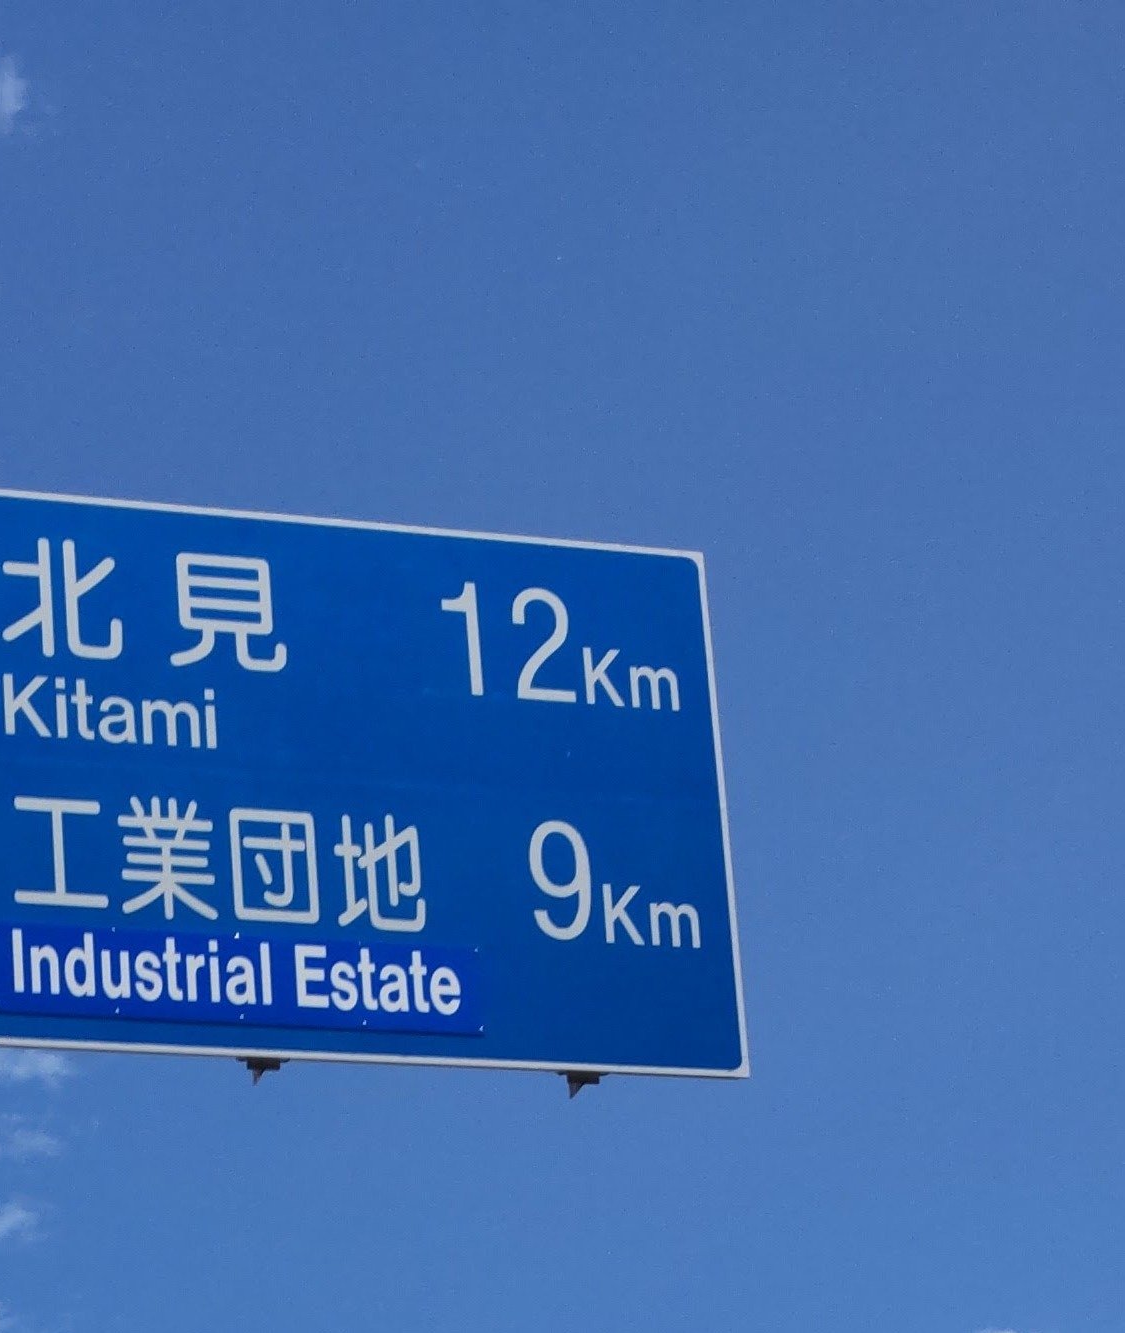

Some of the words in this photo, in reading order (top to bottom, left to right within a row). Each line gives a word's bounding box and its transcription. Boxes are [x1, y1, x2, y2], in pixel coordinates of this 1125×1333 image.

[2, 538, 287, 672] 北見
[3, 673, 217, 749] Kitami
[14, 796, 426, 932] 工業団地
[12, 929, 273, 1005] Industrial
[294, 946, 461, 1015] Estate
